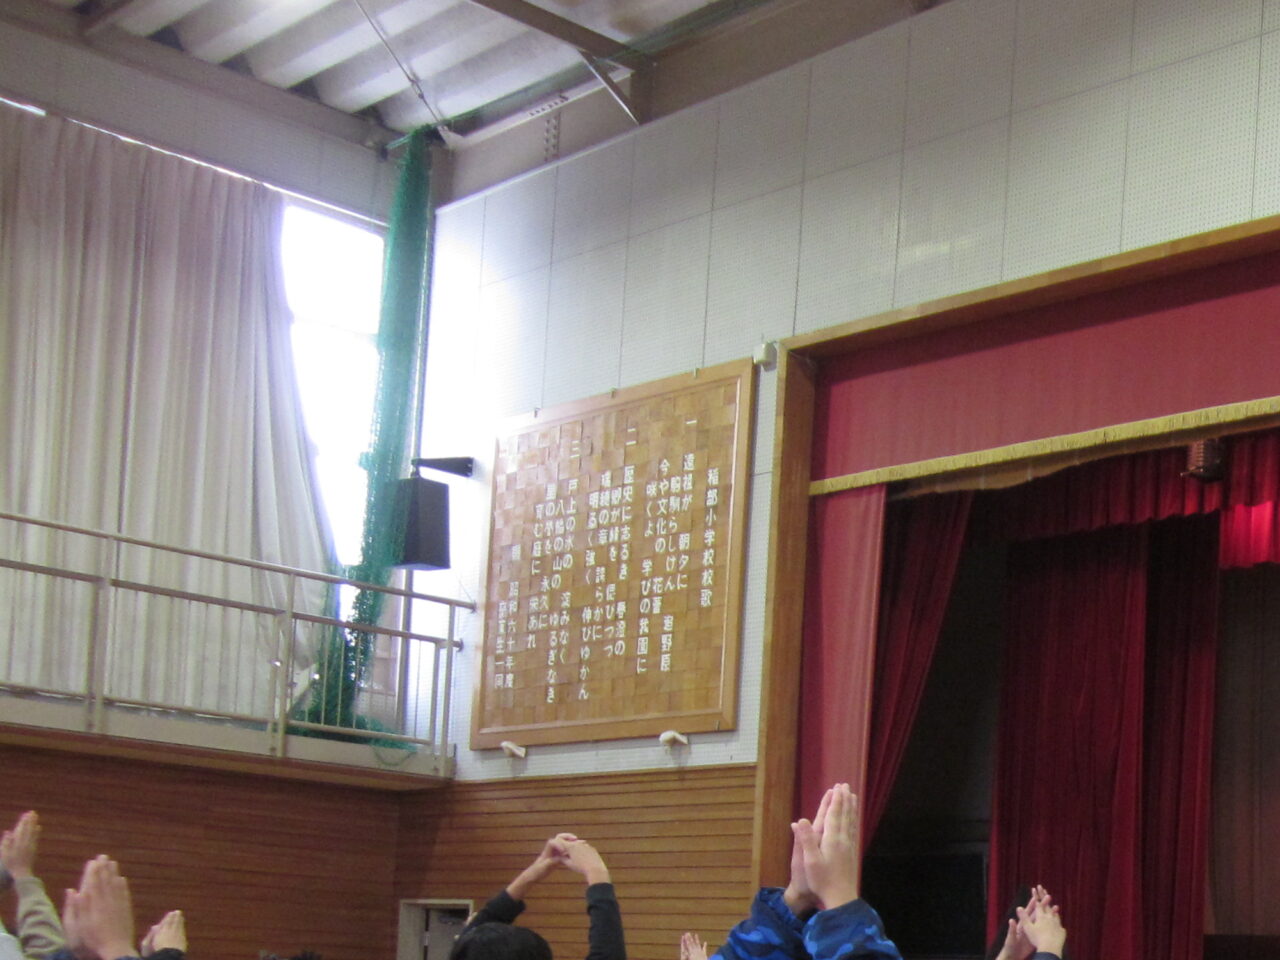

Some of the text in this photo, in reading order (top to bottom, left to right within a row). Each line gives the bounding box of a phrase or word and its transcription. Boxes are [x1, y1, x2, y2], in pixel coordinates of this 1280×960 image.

[655, 458, 669, 552] 今や文化の
[700, 467, 719, 607] 稲部小学校校歌
[577, 492, 599, 699] 明るく強く 伸びゆかん
[676, 532, 690, 589] 朝夕に
[545, 613, 559, 702] ゆるぎなき
